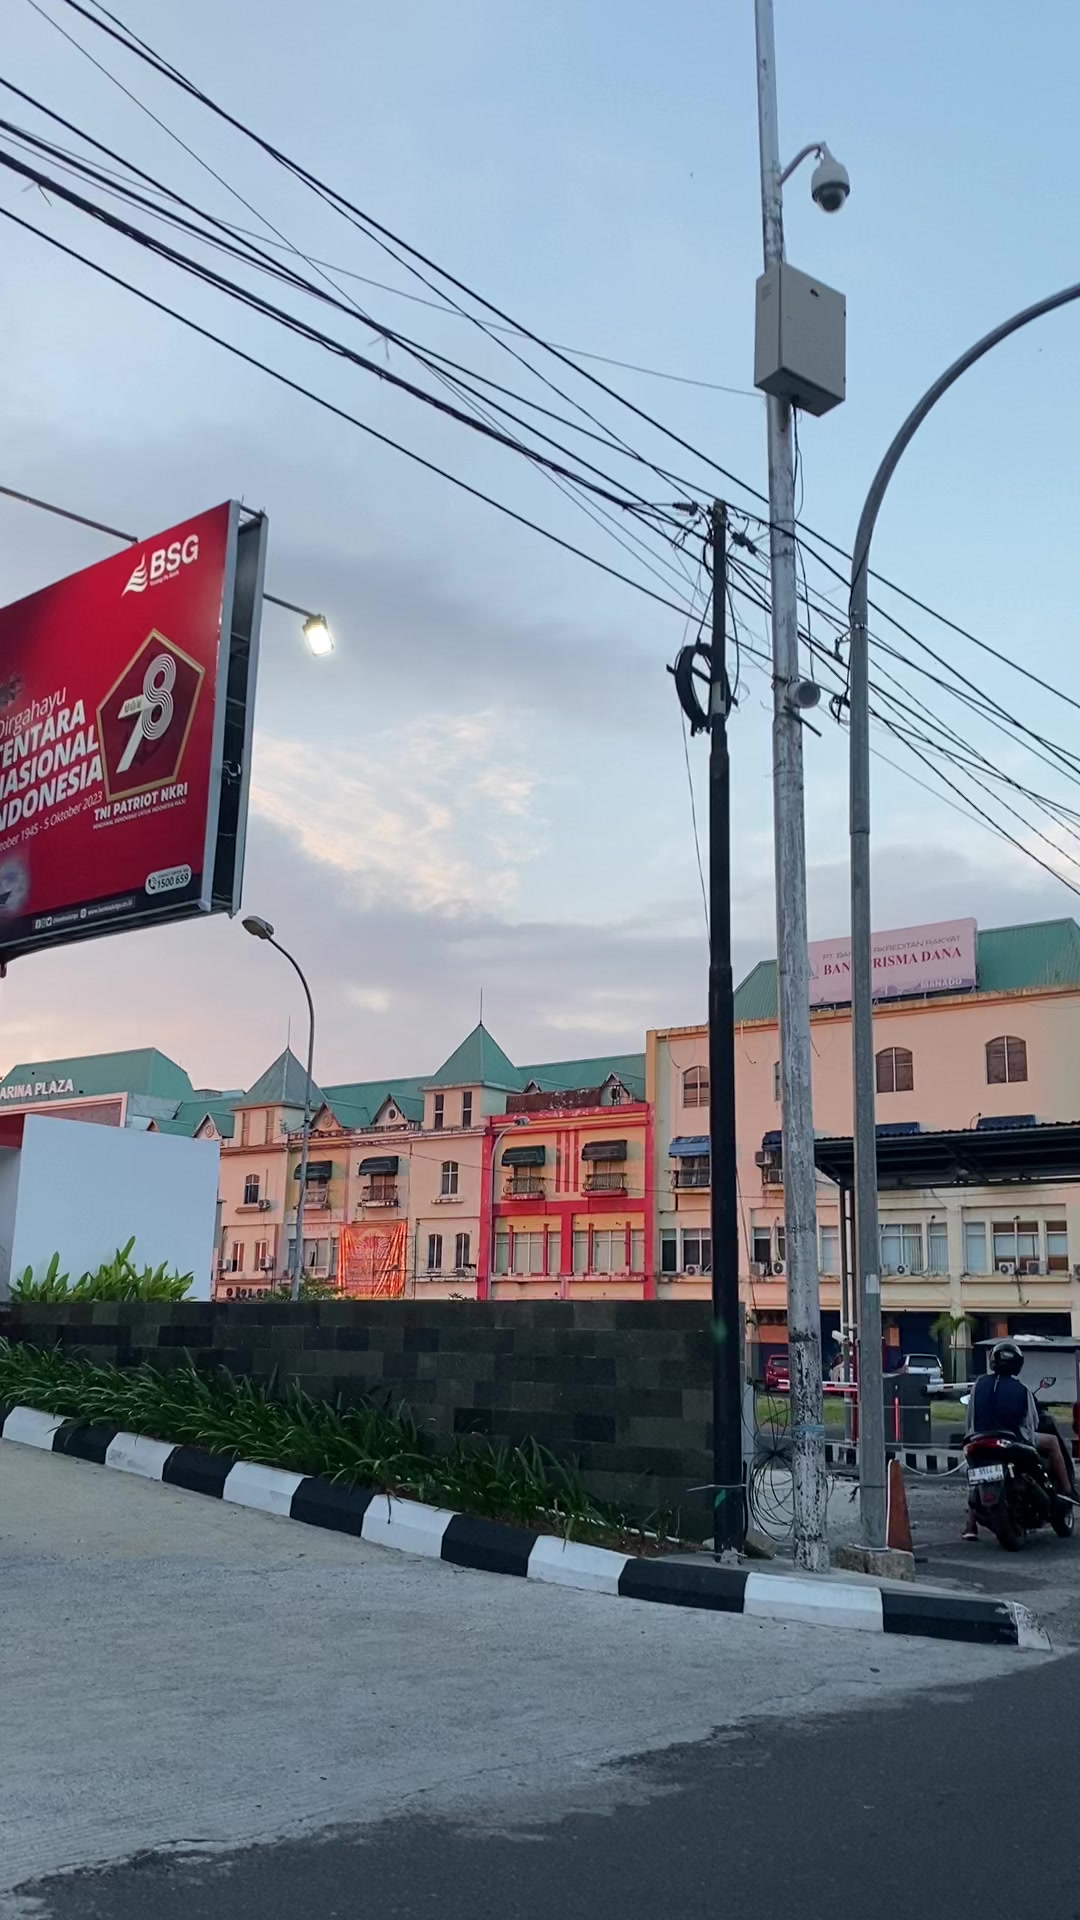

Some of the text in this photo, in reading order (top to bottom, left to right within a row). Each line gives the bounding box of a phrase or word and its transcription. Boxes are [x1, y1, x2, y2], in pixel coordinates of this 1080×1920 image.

[149, 534, 199, 580] BSG
[0, 755, 103, 832] NDONESIA
[94, 782, 188, 821] TNI PATRIOT NKRI
[21, 822, 40, 842] 1945
[43, 817, 50, 830] 5
[50, 803, 82, 827] Oktober
[82, 791, 103, 811] 2023
[157, 873, 189, 889] 1500 659
[873, 941, 924, 953] RKREDITAN
[925, 935, 961, 946] RAKYAT
[824, 947, 962, 976] BAN RISMA DANA
[0, 1078, 74, 1099] ARINA PLAZA
